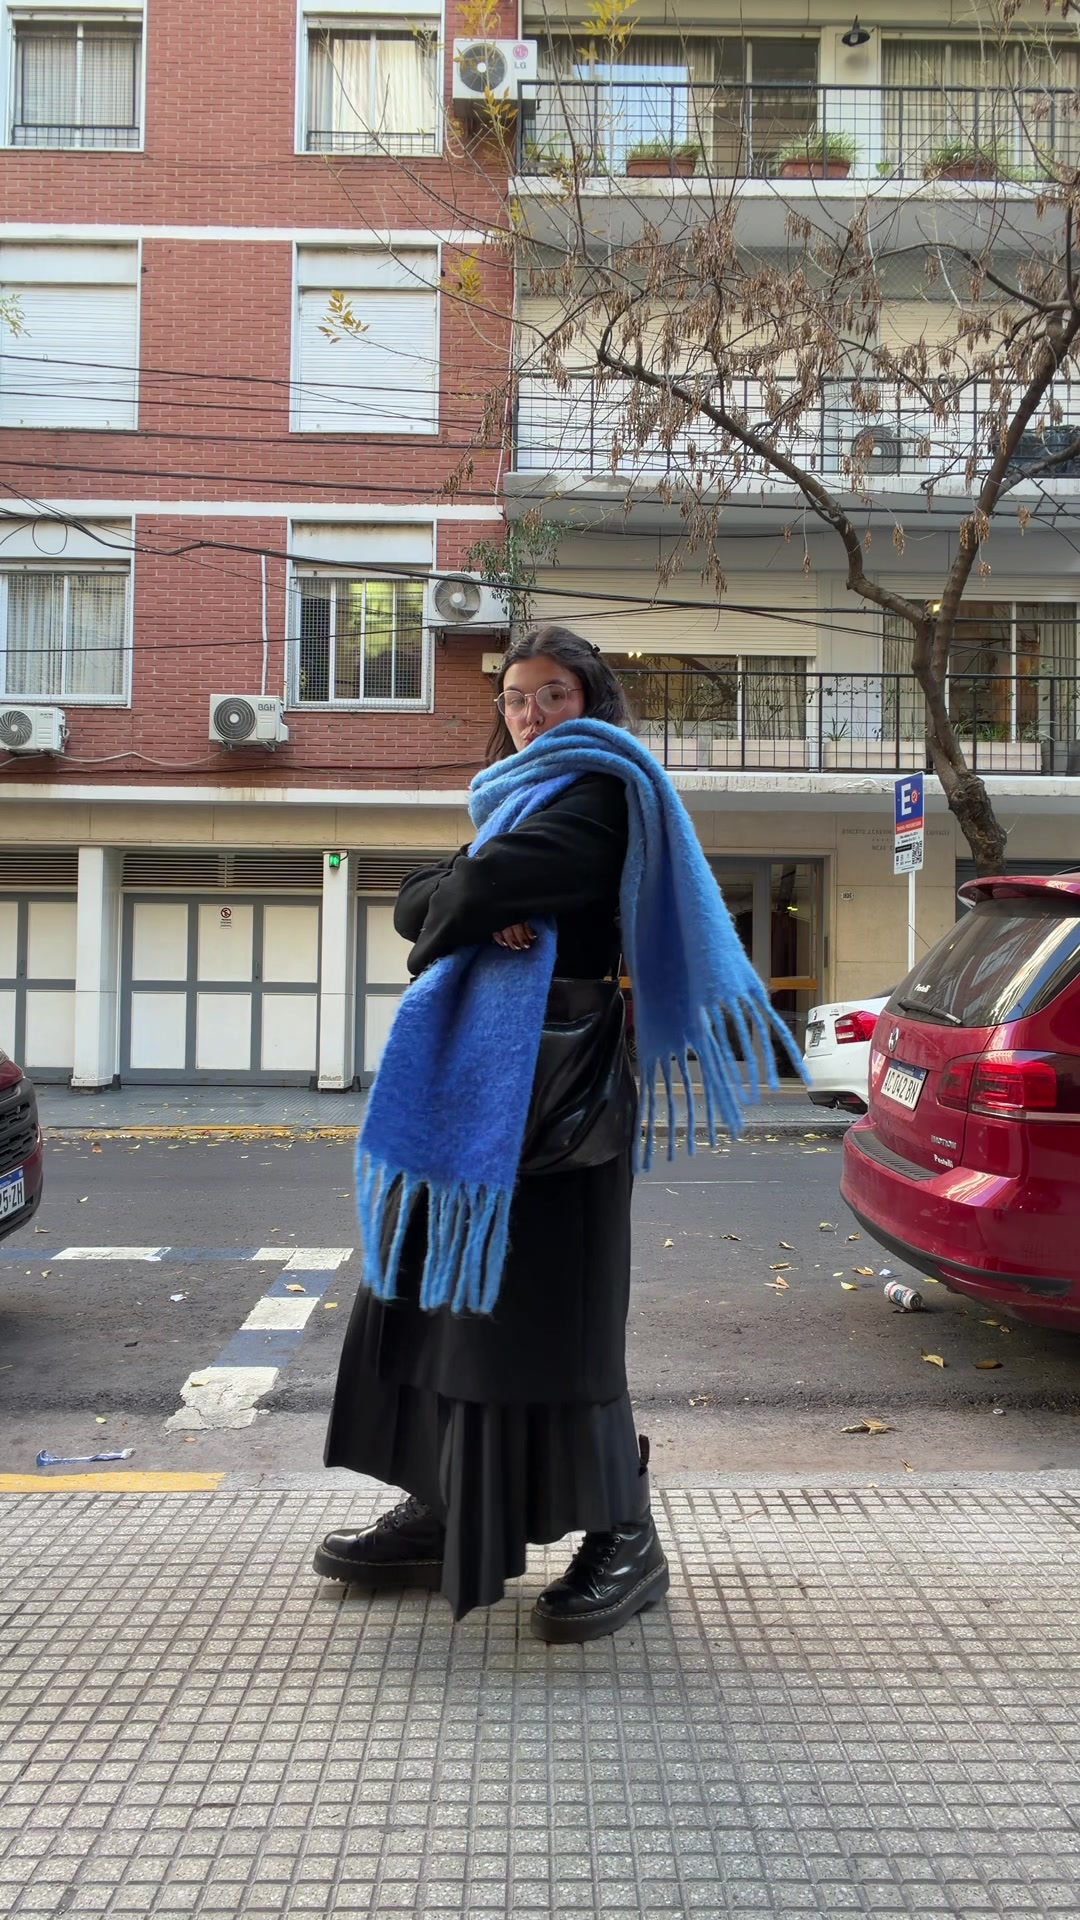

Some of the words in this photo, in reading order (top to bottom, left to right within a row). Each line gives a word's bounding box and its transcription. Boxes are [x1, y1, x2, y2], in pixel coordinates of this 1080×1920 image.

[514, 61, 527, 69] LG
[257, 703, 276, 711] BGH
[901, 782, 912, 816] E
[892, 1073, 908, 1099] 042
[904, 1079, 919, 1104] BN
[11, 1181, 23, 1208] ZH
